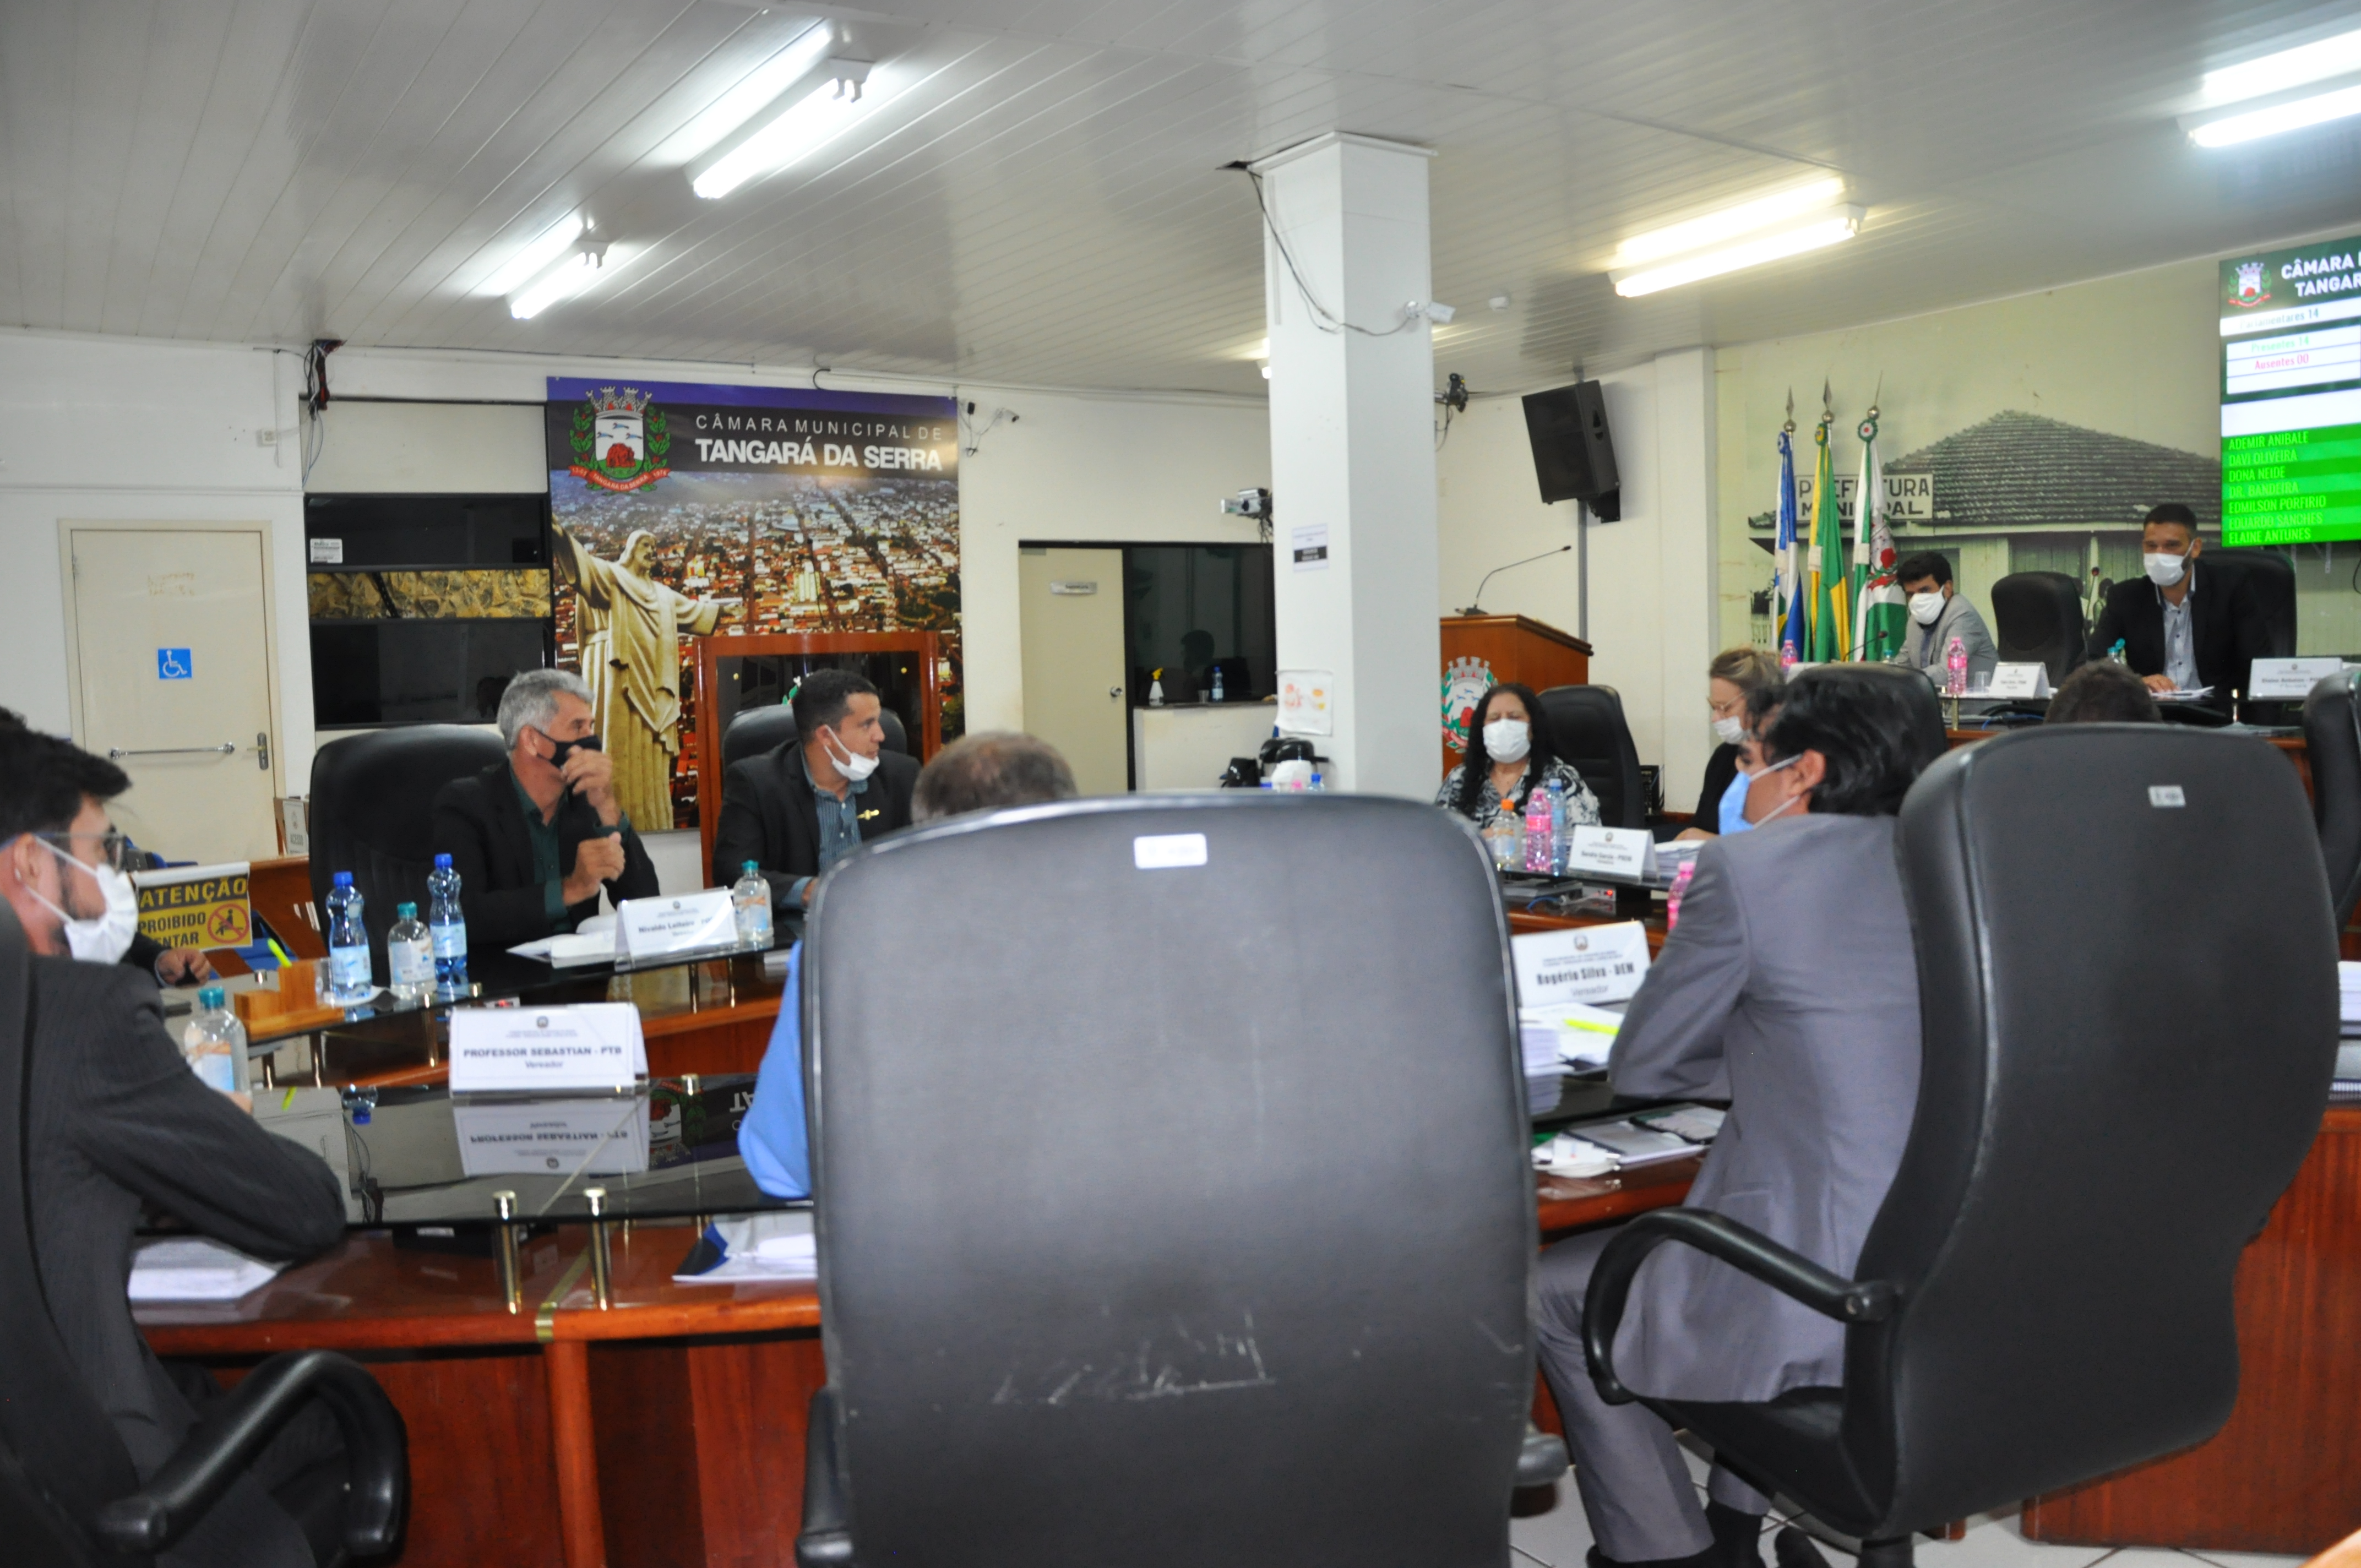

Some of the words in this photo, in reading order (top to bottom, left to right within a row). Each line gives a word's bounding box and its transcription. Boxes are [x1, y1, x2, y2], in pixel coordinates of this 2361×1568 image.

[2281, 253, 2355, 279] CÂMARA
[2308, 308, 2319, 319] 14
[2251, 340, 2295, 353] Presentes
[2299, 335, 2309, 346] 14
[2255, 357, 2295, 370] Ausentes
[2297, 353, 2309, 364] 00
[696, 413, 788, 432] CÂMARA
[795, 419, 911, 439] MUNICIPAL
[918, 426, 942, 440] DE
[2228, 435, 2266, 450] ADEMIR
[2267, 431, 2309, 447] ANIBALE
[695, 436, 818, 466] TANGARÁ
[824, 443, 858, 467] DA
[864, 446, 943, 471] SERRA
[2229, 454, 2251, 467] DAVI
[2253, 449, 2298, 465] OLIVEIRA
[2229, 469, 2255, 483] DONA
[2257, 466, 2286, 480] NEIDE
[1799, 478, 1929, 498] PFURA
[2248, 481, 2299, 497] BANDEIRA
[2229, 499, 2278, 514] EDMILSON
[2229, 516, 2275, 530] EDUARDO
[2277, 512, 2324, 527] SANCHES
[2229, 530, 2262, 545] ELAINE
[2264, 527, 2311, 542] ANTUNES
[140, 876, 248, 908] ATENÇÃO
[138, 912, 206, 934] PROIBIDO
[157, 932, 199, 948] NTAR
[464, 1047, 527, 1058] PROFESSOR
[531, 1046, 591, 1057] SEBASTIAN
